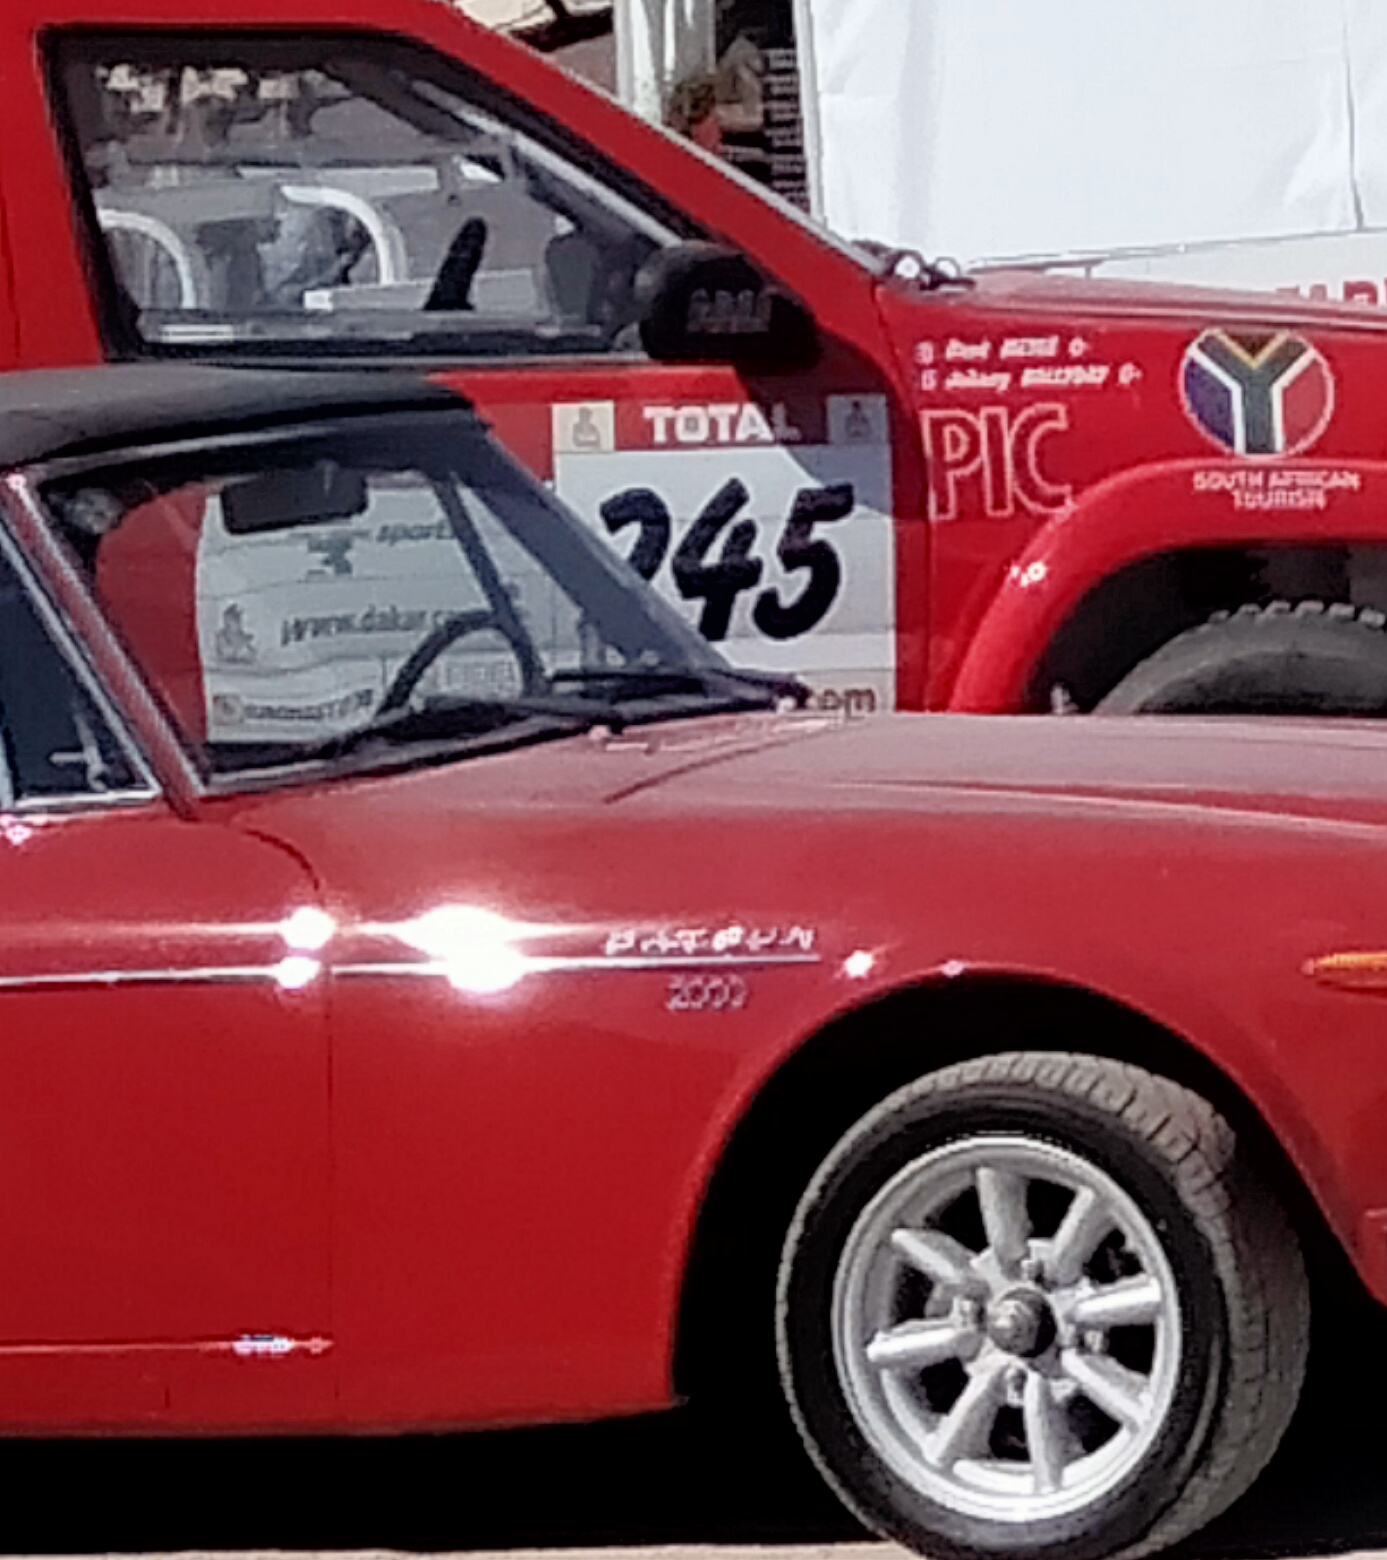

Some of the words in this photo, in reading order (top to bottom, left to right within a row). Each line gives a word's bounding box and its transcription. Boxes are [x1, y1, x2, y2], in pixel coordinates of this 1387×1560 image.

[643, 402, 799, 444] TOTAL
[920, 402, 1077, 522] PIC
[1193, 469, 1263, 491] SOUTH
[1268, 469, 1361, 491] AFRICAN
[600, 477, 855, 642] 245
